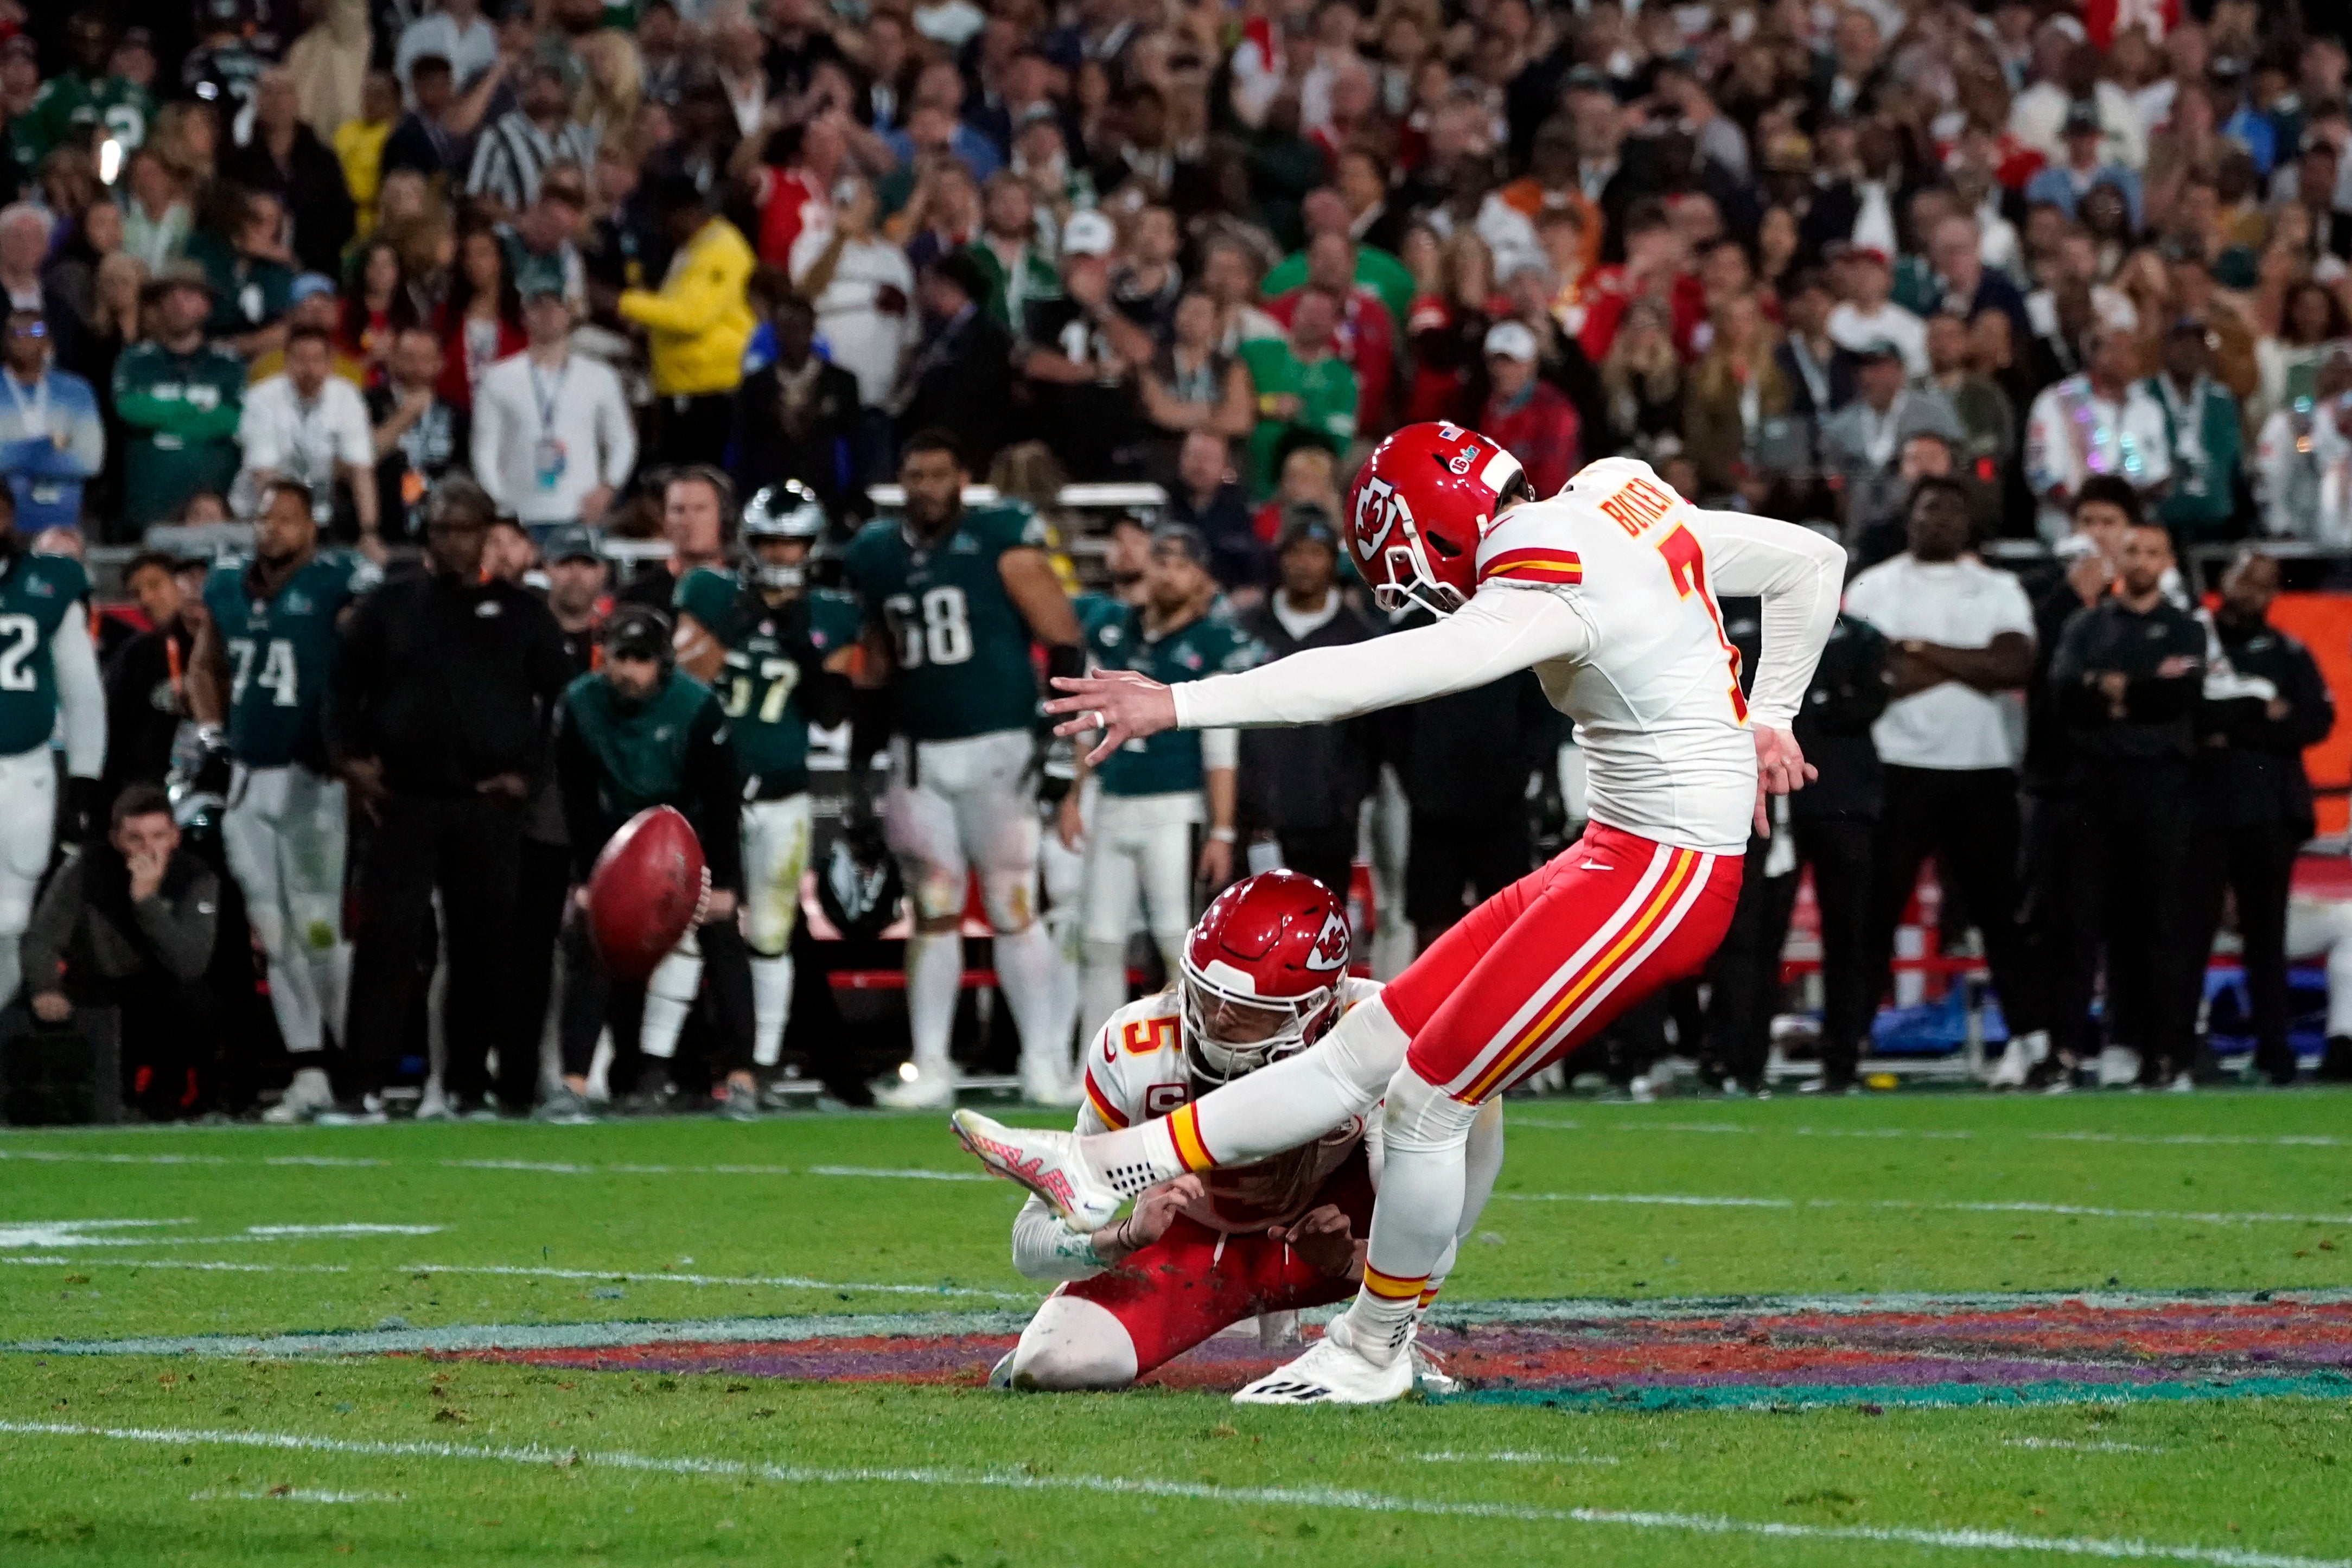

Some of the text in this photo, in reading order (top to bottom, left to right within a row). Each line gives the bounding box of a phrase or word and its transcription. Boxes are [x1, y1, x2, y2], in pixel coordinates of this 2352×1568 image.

[1452, 459, 1467, 472] 16
[882, 585, 975, 668] 68
[1655, 520, 1749, 728] 7
[228, 636, 299, 707] 74
[1121, 1015, 1182, 1057] 5
[1149, 1086, 1185, 1112] C
